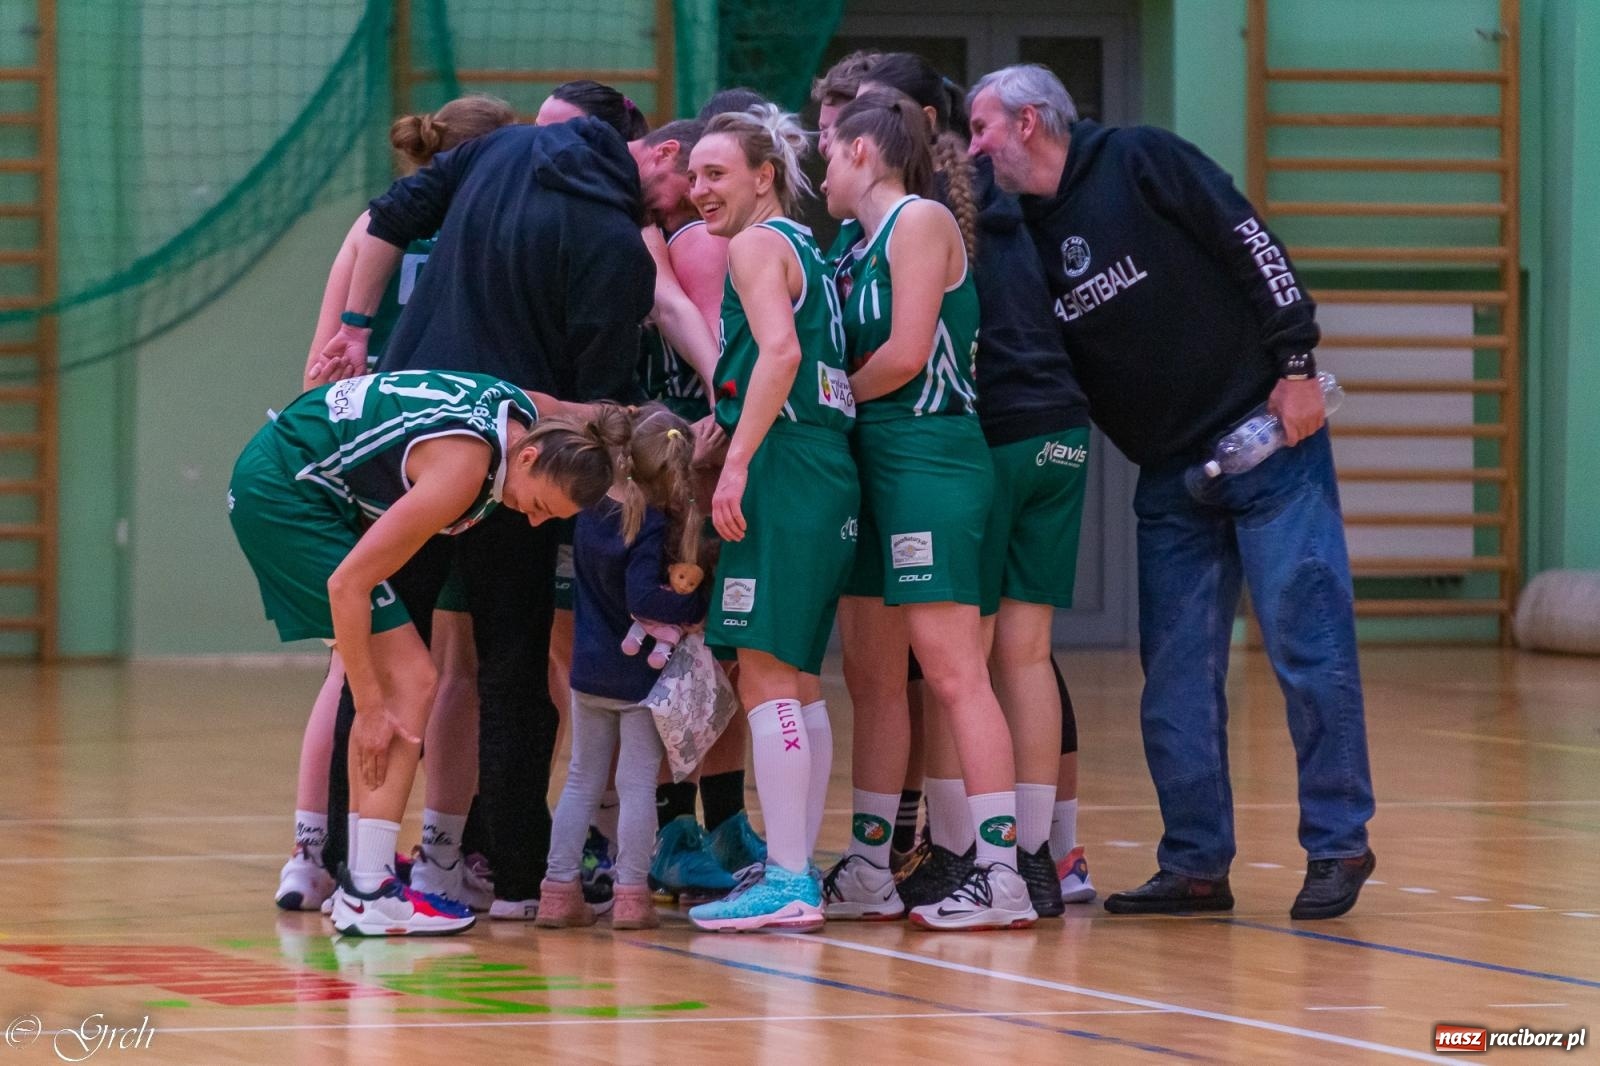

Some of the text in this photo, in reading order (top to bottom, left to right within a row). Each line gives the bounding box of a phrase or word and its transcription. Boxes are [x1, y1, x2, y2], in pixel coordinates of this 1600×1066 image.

[1054, 255, 1148, 322] ASKETBALL
[1233, 216, 1302, 307] PREZES
[859, 279, 881, 325] 11
